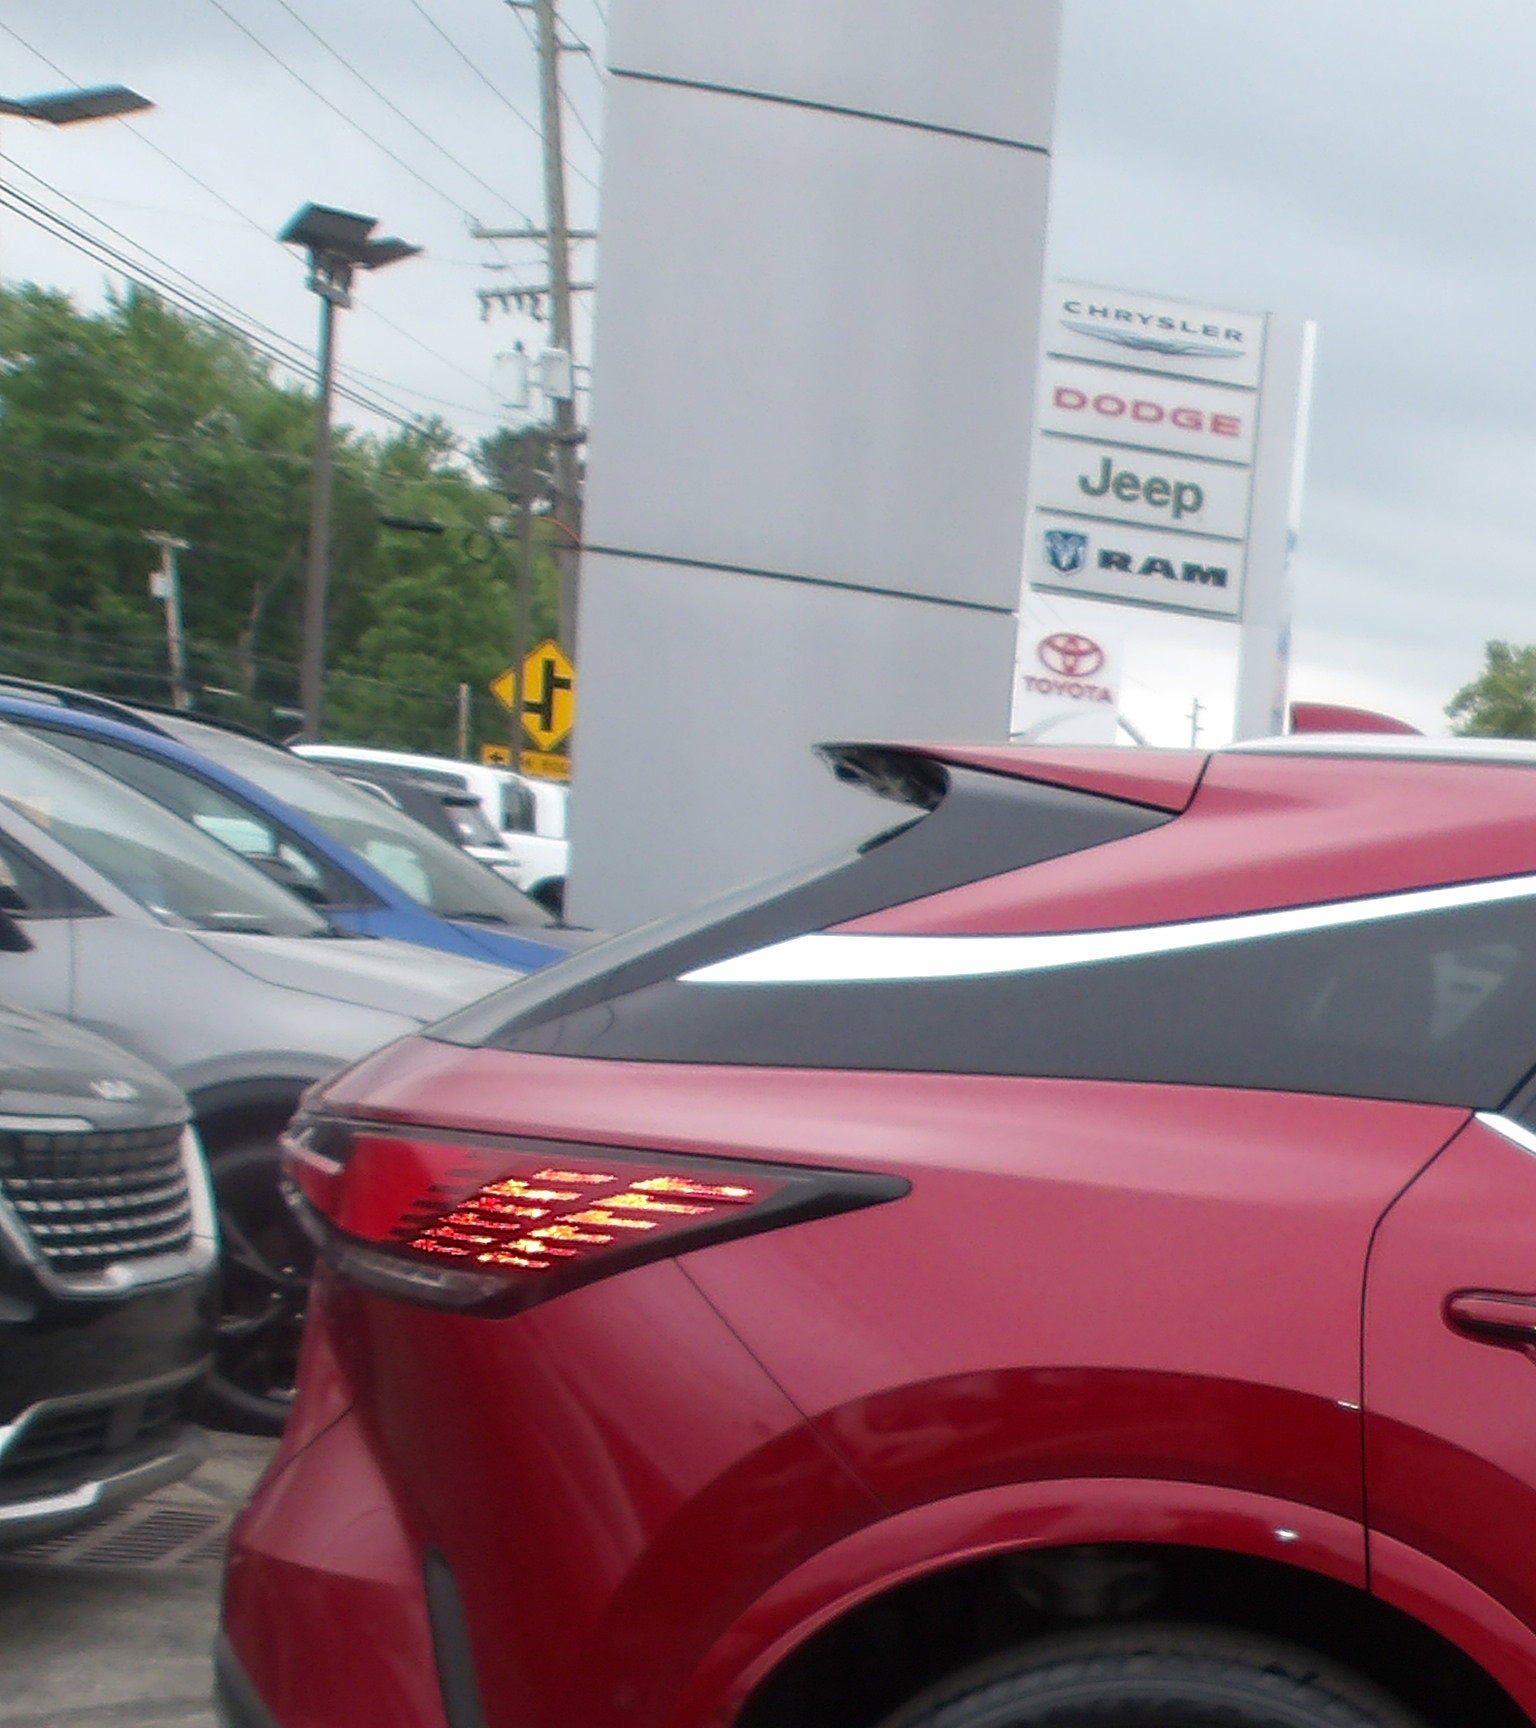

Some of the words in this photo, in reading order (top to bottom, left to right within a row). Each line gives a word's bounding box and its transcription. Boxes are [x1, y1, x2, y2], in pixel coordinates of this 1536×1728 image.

[1063, 300, 1244, 342] CHRYSLER
[1054, 387, 1242, 438] DODGE
[1078, 456, 1203, 519] Jeep
[1097, 548, 1228, 587] RAM
[1023, 675, 1113, 704] TOYOTA
